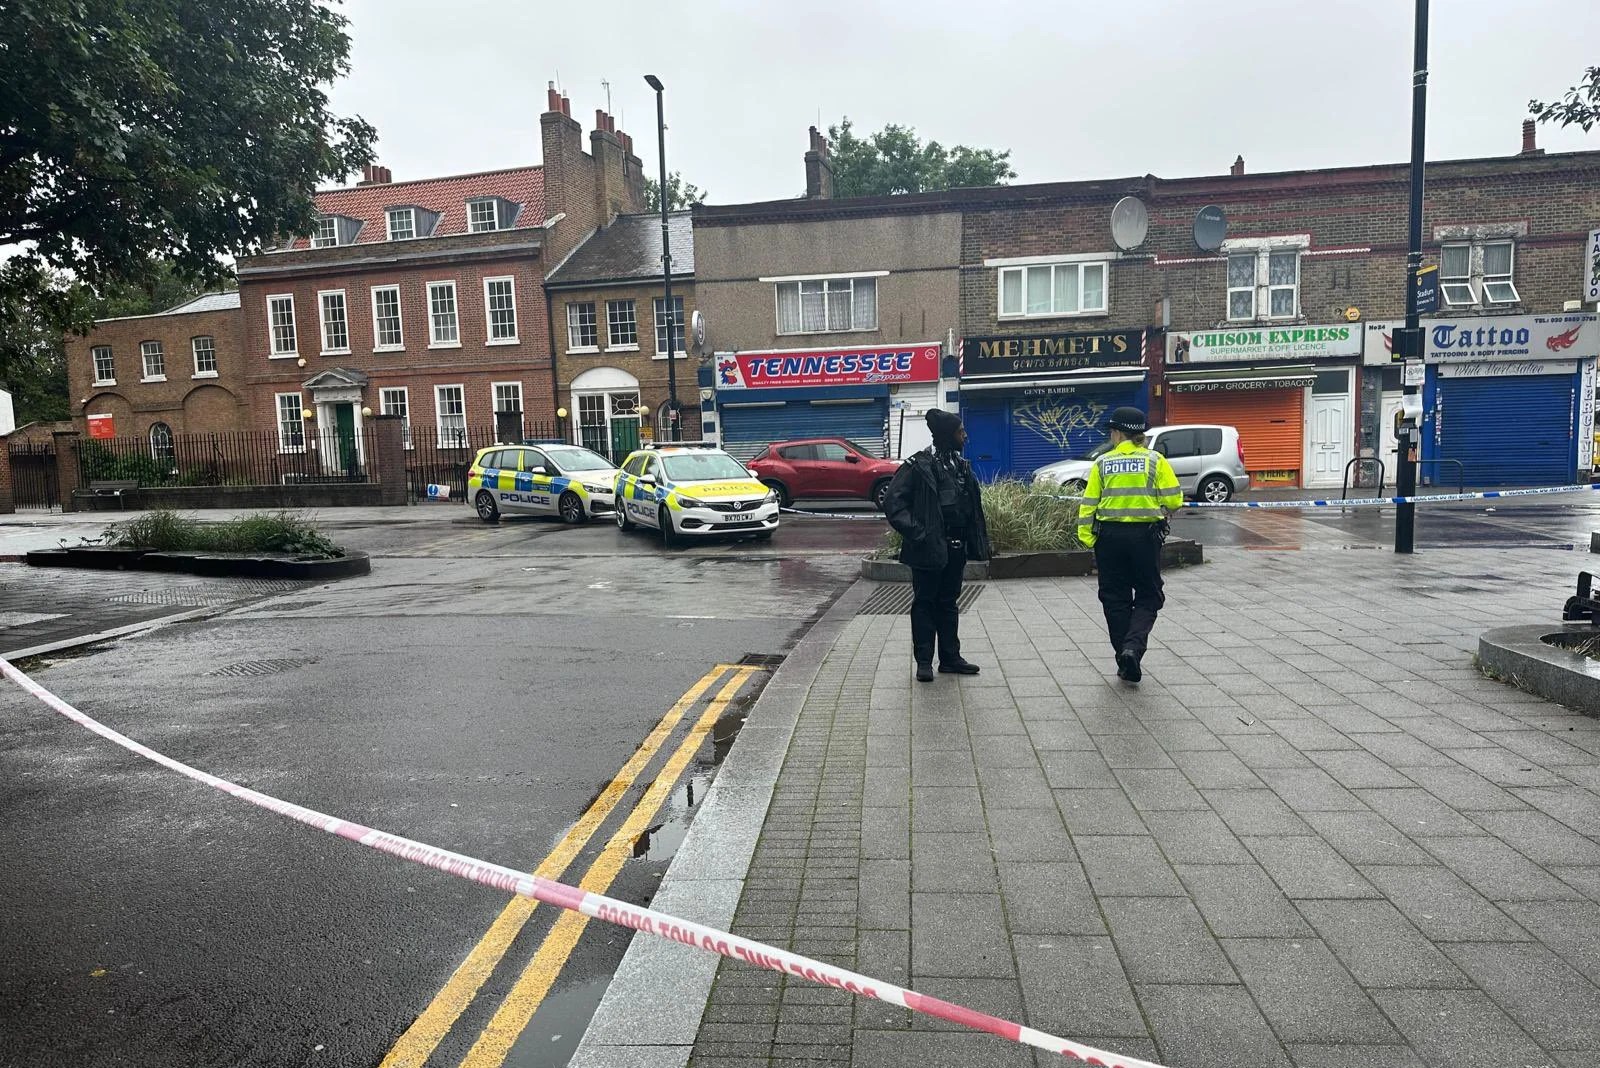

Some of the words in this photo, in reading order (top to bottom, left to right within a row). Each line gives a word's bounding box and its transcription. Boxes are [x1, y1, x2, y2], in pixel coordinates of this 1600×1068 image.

[1193, 331, 1262, 348] CHISOM
[1268, 327, 1350, 344] EXPRESS
[1432, 324, 1529, 349] Tattoo
[977, 335, 1127, 358] MEHMET'S
[1210, 345, 1267, 354] SUPERMARKET
[1293, 343, 1327, 351] LICENCE
[748, 352, 914, 378] TENNESSEE
[1013, 360, 1045, 370] GENTS
[1048, 358, 1090, 367] BARBER
[862, 373, 911, 382] Express
[1207, 383, 1219, 391] UP
[1225, 381, 1265, 390] GROCERY
[1274, 379, 1314, 388] TOBACCO
[1582, 363, 1594, 465] PIERCING
[1105, 463, 1145, 474] POLICE
[500, 493, 550, 505] POLICE
[627, 502, 656, 519] POLICE
